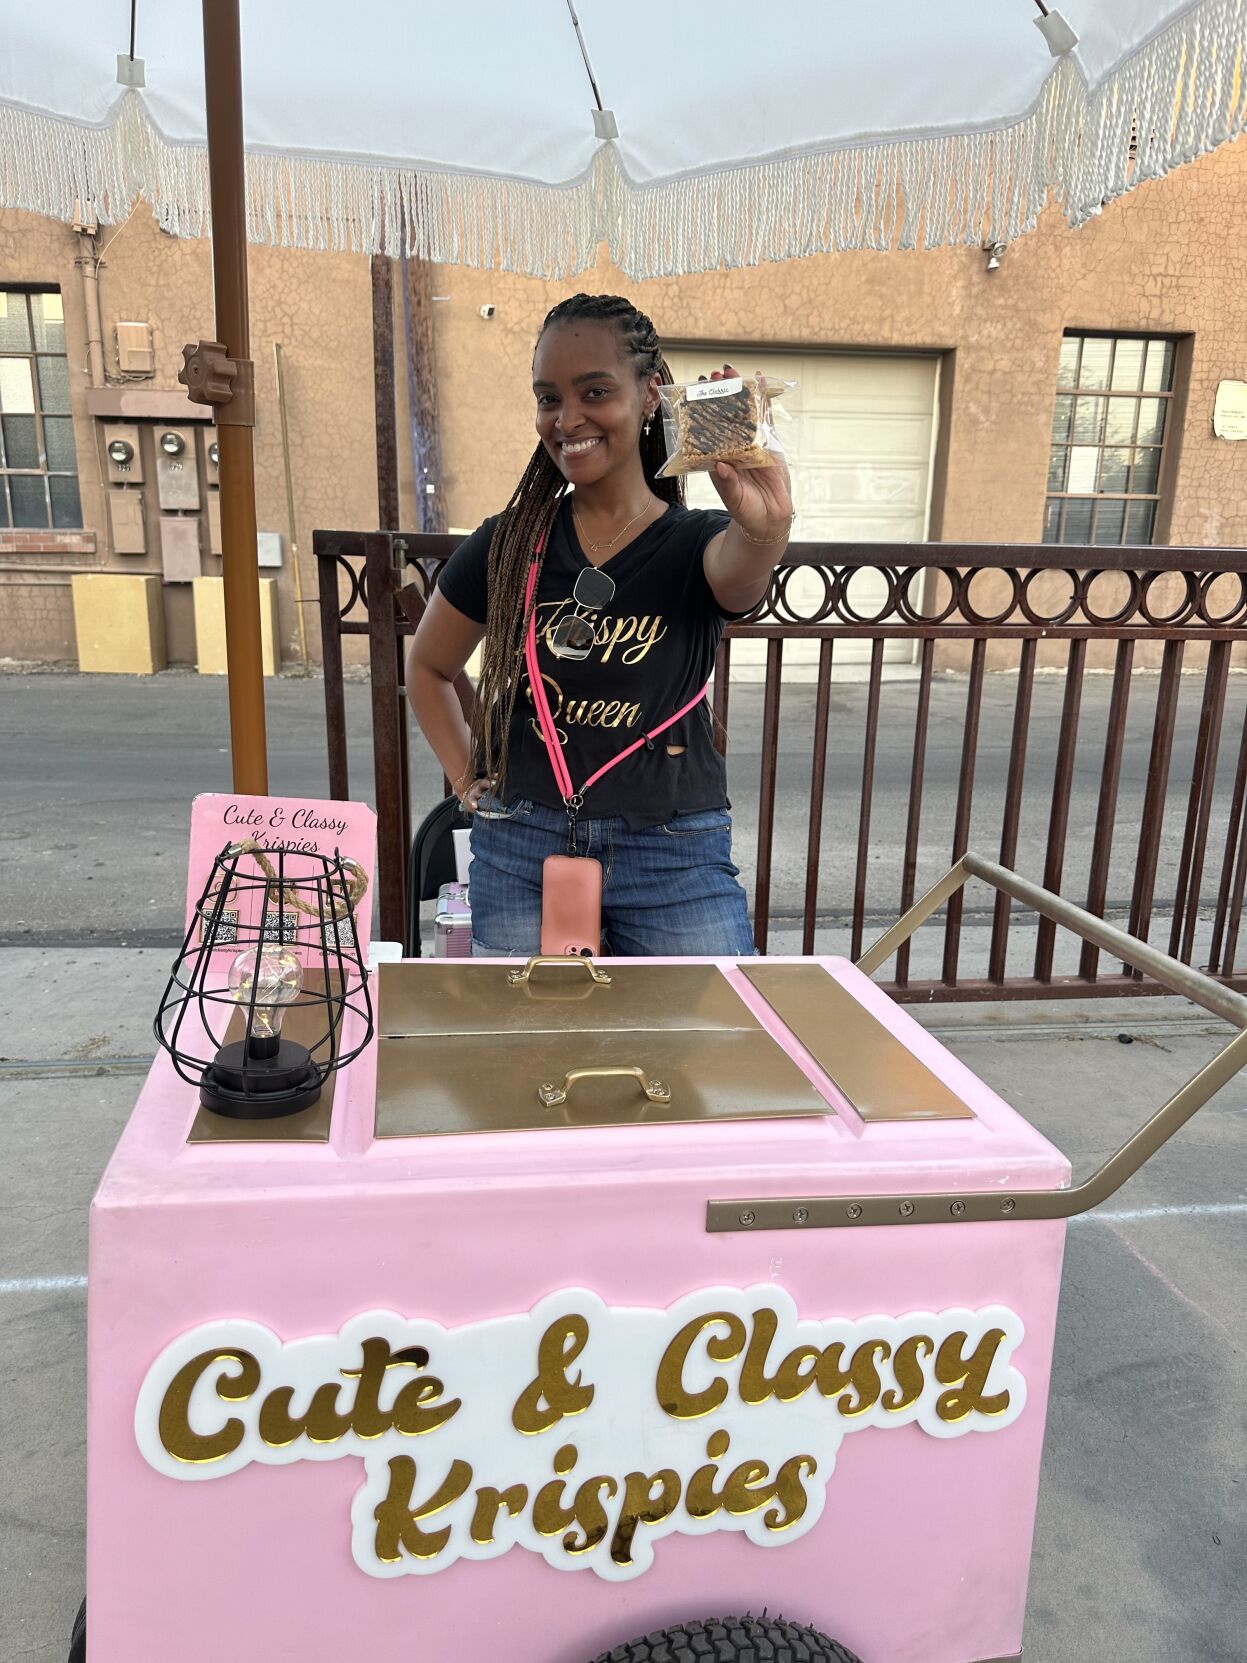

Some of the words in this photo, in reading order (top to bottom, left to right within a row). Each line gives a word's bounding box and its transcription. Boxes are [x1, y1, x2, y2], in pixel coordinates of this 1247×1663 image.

[535, 597, 668, 665] Kspy
[520, 671, 643, 745] Queen
[223, 804, 264, 826] Cute
[268, 807, 286, 828] &
[291, 808, 349, 836] Classy
[158, 1336, 463, 1464] Cute
[511, 1313, 596, 1436] &
[656, 1307, 1011, 1423] Classy
[374, 1429, 818, 1567] Krispies
